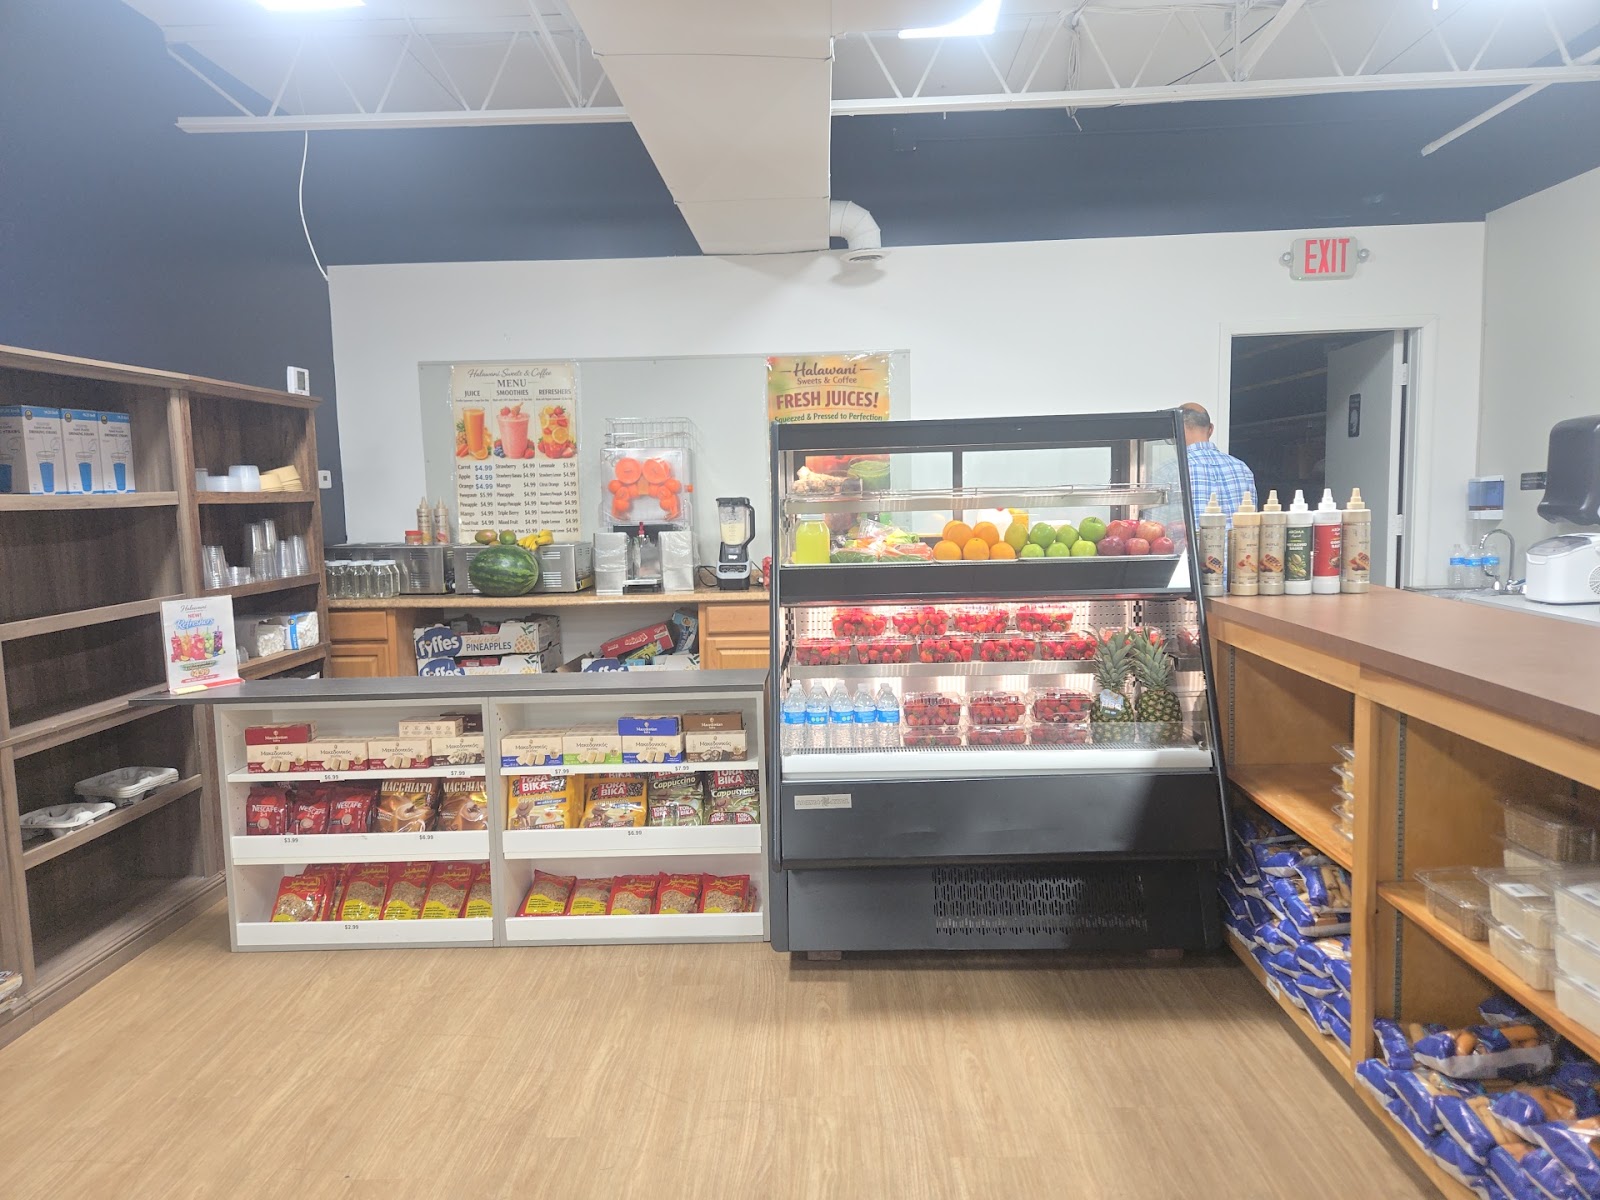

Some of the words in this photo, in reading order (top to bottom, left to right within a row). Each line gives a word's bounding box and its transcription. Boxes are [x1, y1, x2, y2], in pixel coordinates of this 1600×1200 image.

[1304, 238, 1350, 274] EXIT
[501, 368, 522, 377] Sweets
[530, 368, 552, 378] Coffee
[793, 362, 857, 377] Halawani
[497, 379, 527, 388] MENU
[796, 377, 822, 385] Sweets
[833, 376, 857, 384] Coffee
[776, 390, 821, 410] FRESH
[825, 390, 879, 408] JUICES!
[774, 413, 805, 423] Squeezed
[849, 412, 882, 420] Perfection
[418, 635, 460, 656] fyffes
[466, 641, 512, 651] PINEAPPLES
[653, 777, 696, 790] Cappuccino
[718, 776, 742, 784] BIKA
[381, 781, 432, 793] MACCHIATO
[443, 781, 487, 793] MACCHIAT
[522, 782, 548, 792] BIKA
[601, 788, 625, 796] BIKA
[712, 787, 755, 798] Cappuccino
